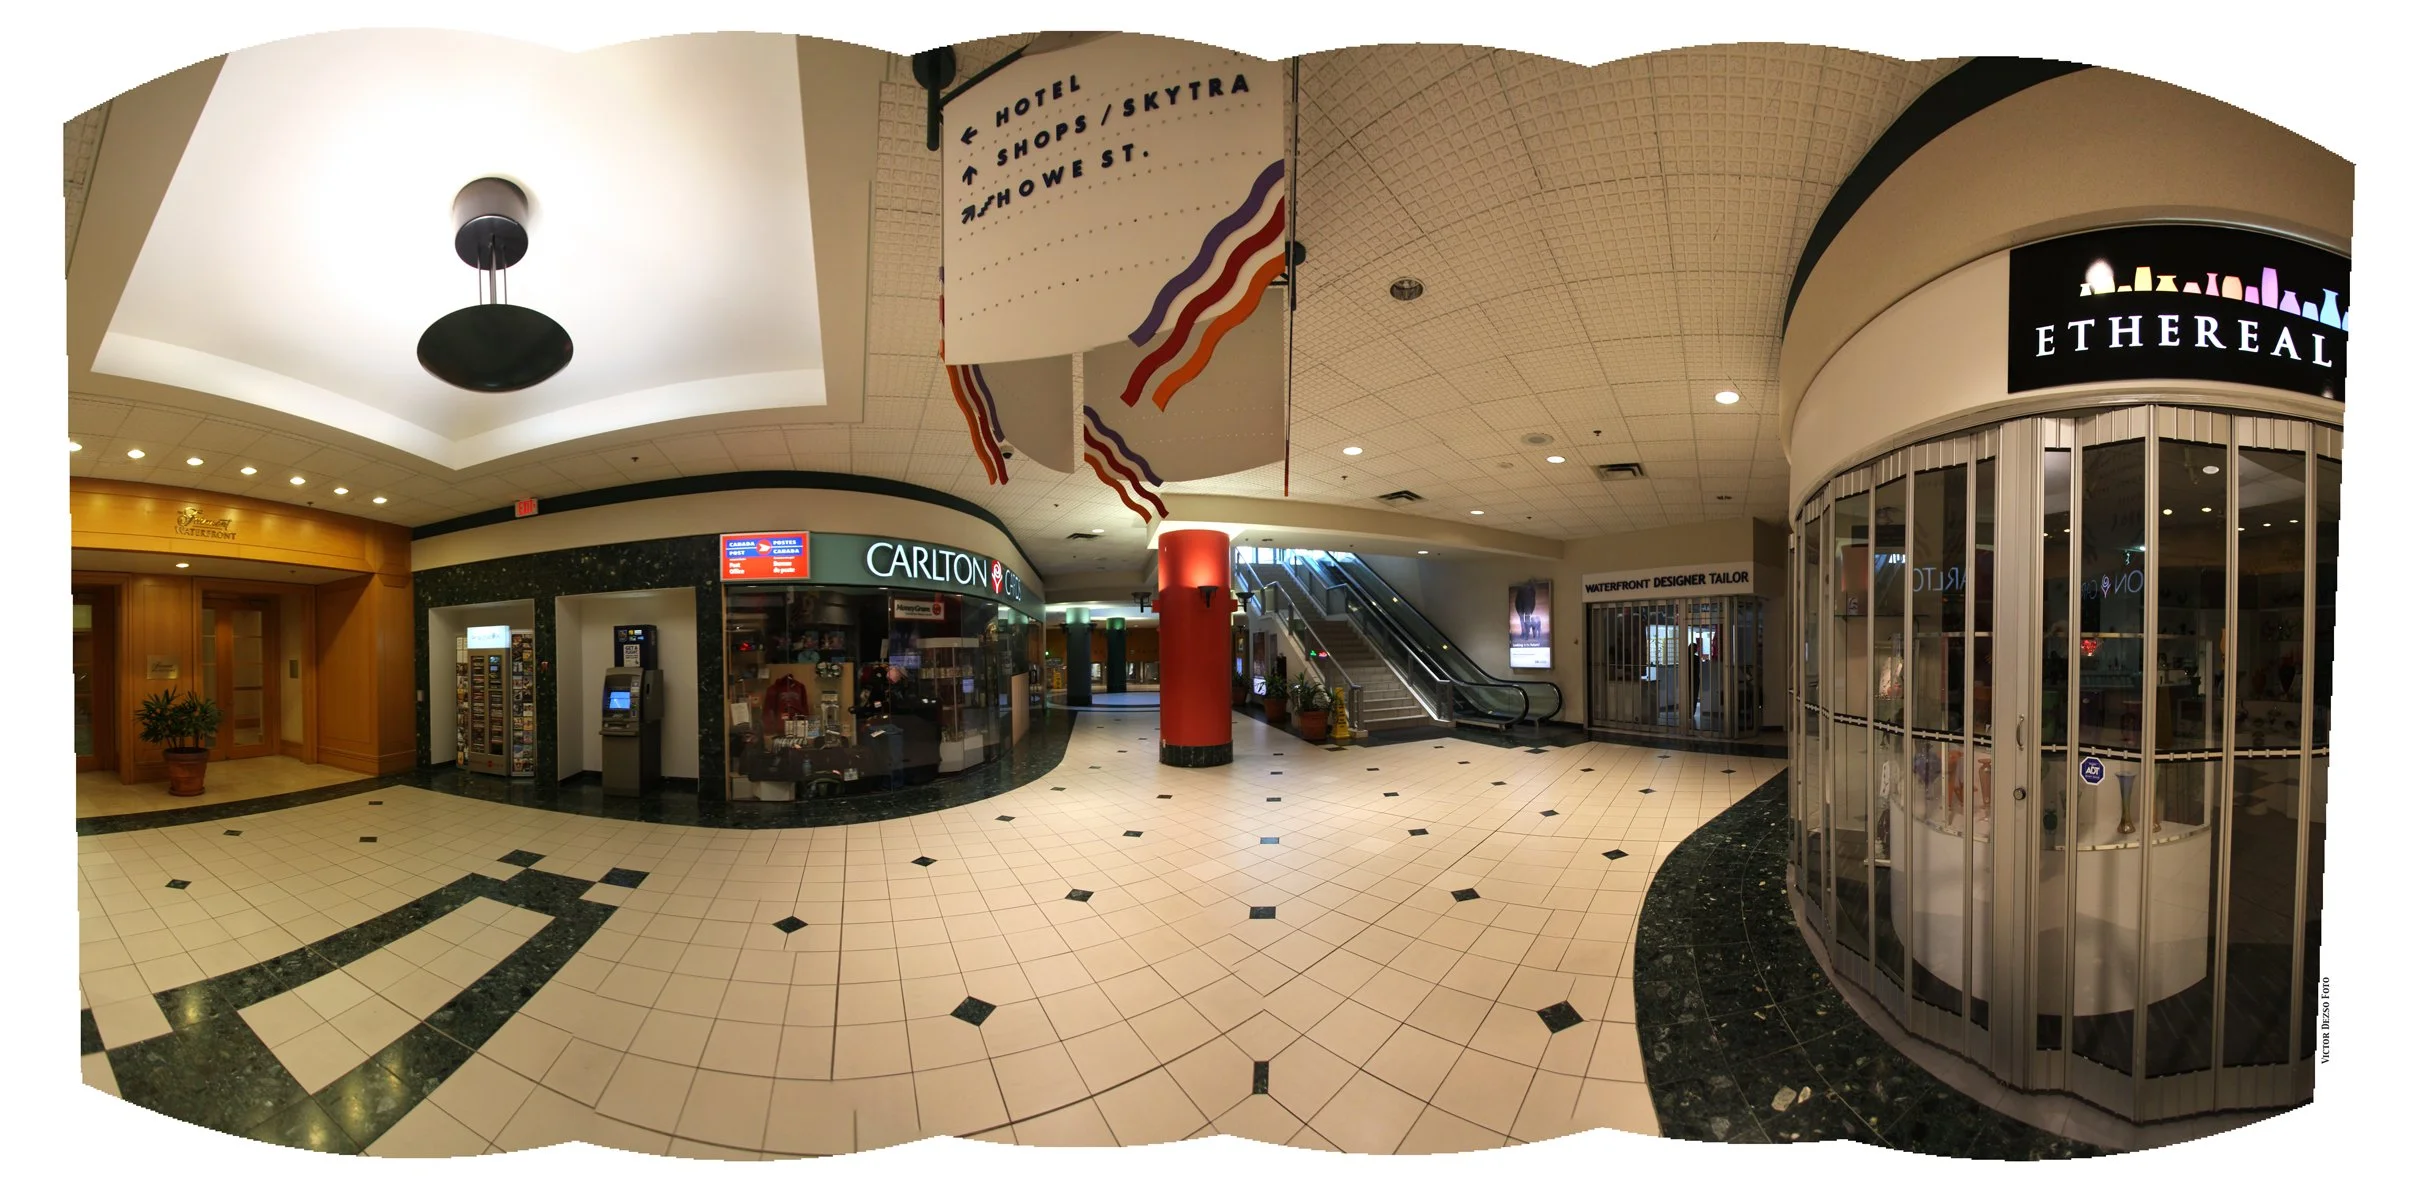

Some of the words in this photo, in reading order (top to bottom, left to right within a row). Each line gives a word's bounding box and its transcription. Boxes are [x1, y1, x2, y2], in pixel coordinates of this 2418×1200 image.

[996, 75, 1081, 127] HOTEL
[997, 115, 1087, 167] SHOPS
[1122, 73, 1249, 118] SKYTRA
[997, 159, 1083, 208] HOWE
[1101, 143, 1150, 169] ST.
[2035, 315, 2333, 368] ETHEREAL
[518, 500, 533, 515] EXIT
[174, 526, 237, 540] WATERFRONT
[866, 542, 988, 588] CARLTON
[1585, 579, 1651, 594] WATERFRONT
[1653, 574, 1707, 589] DESIGNER
[1708, 571, 1750, 585] TAILOR
[2085, 766, 2100, 776] ADT
